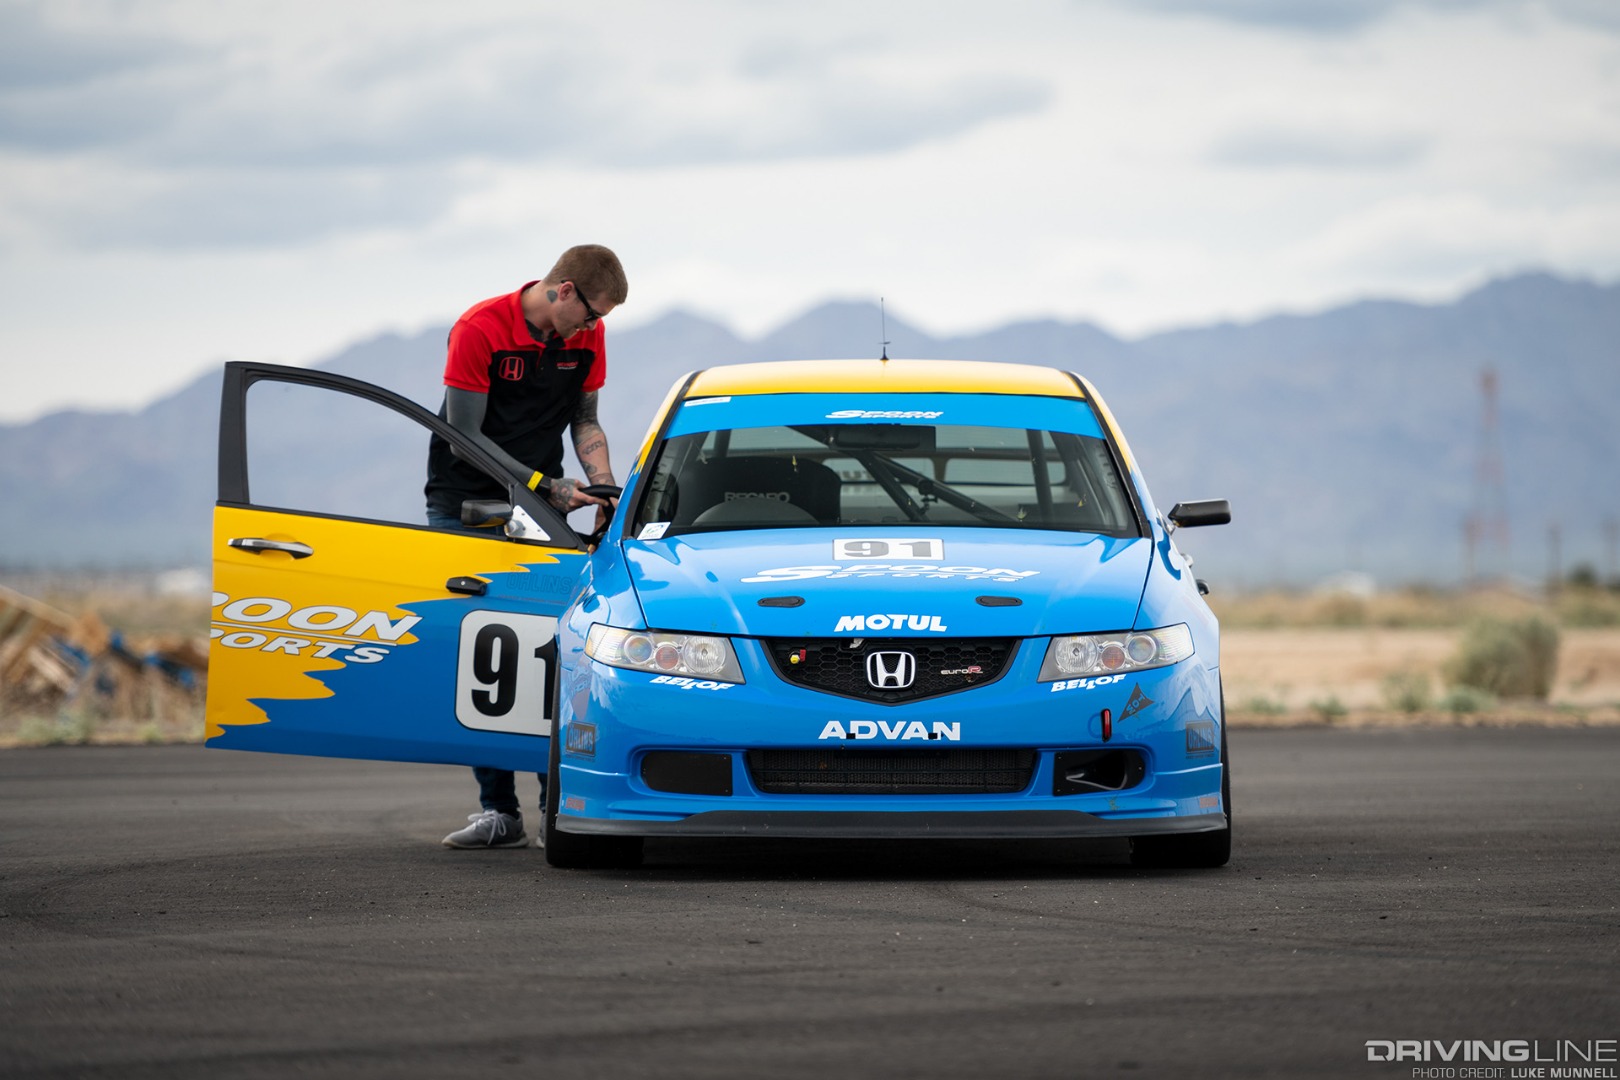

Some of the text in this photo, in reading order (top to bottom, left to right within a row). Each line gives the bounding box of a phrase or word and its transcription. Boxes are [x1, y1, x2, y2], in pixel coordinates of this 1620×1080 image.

[843, 540, 933, 558] 91
[740, 564, 1041, 583] SPOON
[834, 613, 947, 632] MOTUL
[1050, 673, 1127, 692] BELLOF
[818, 720, 961, 741] ADVAN
